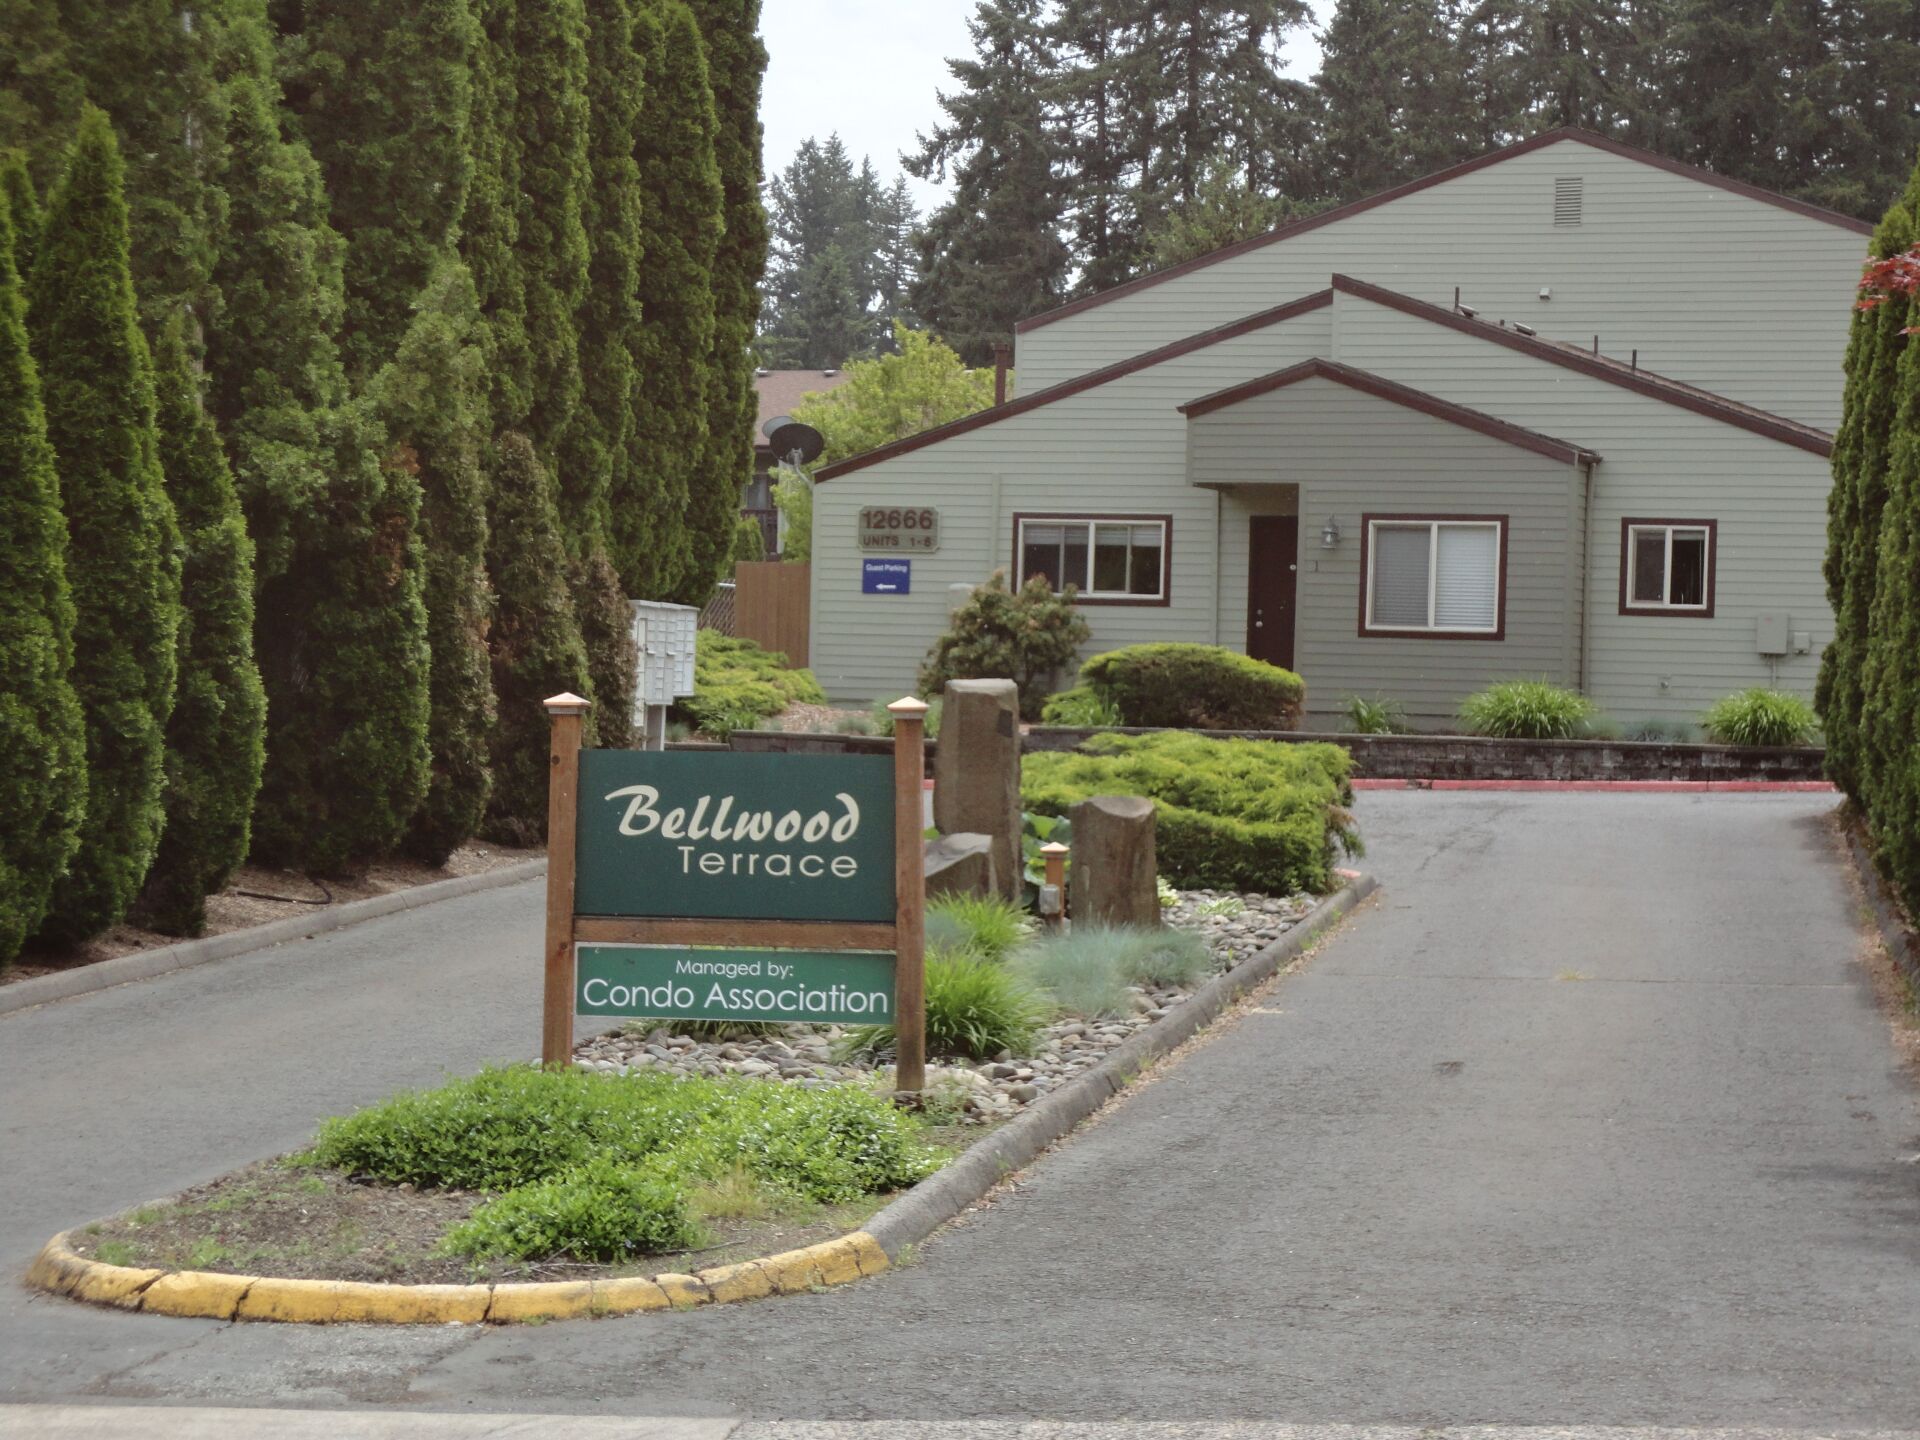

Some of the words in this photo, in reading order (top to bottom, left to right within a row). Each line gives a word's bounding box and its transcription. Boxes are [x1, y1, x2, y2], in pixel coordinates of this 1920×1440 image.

[863, 510, 933, 529] 12666
[863, 535, 899, 546] UNITS
[866, 563, 884, 571] Guest
[884, 564, 907, 573] Parking
[604, 784, 860, 843] Bellwood
[677, 845, 859, 878] Terrace
[675, 959, 761, 978] Managed
[767, 961, 794, 979] by:
[583, 978, 695, 1008] Condo
[703, 981, 889, 1013] Association
